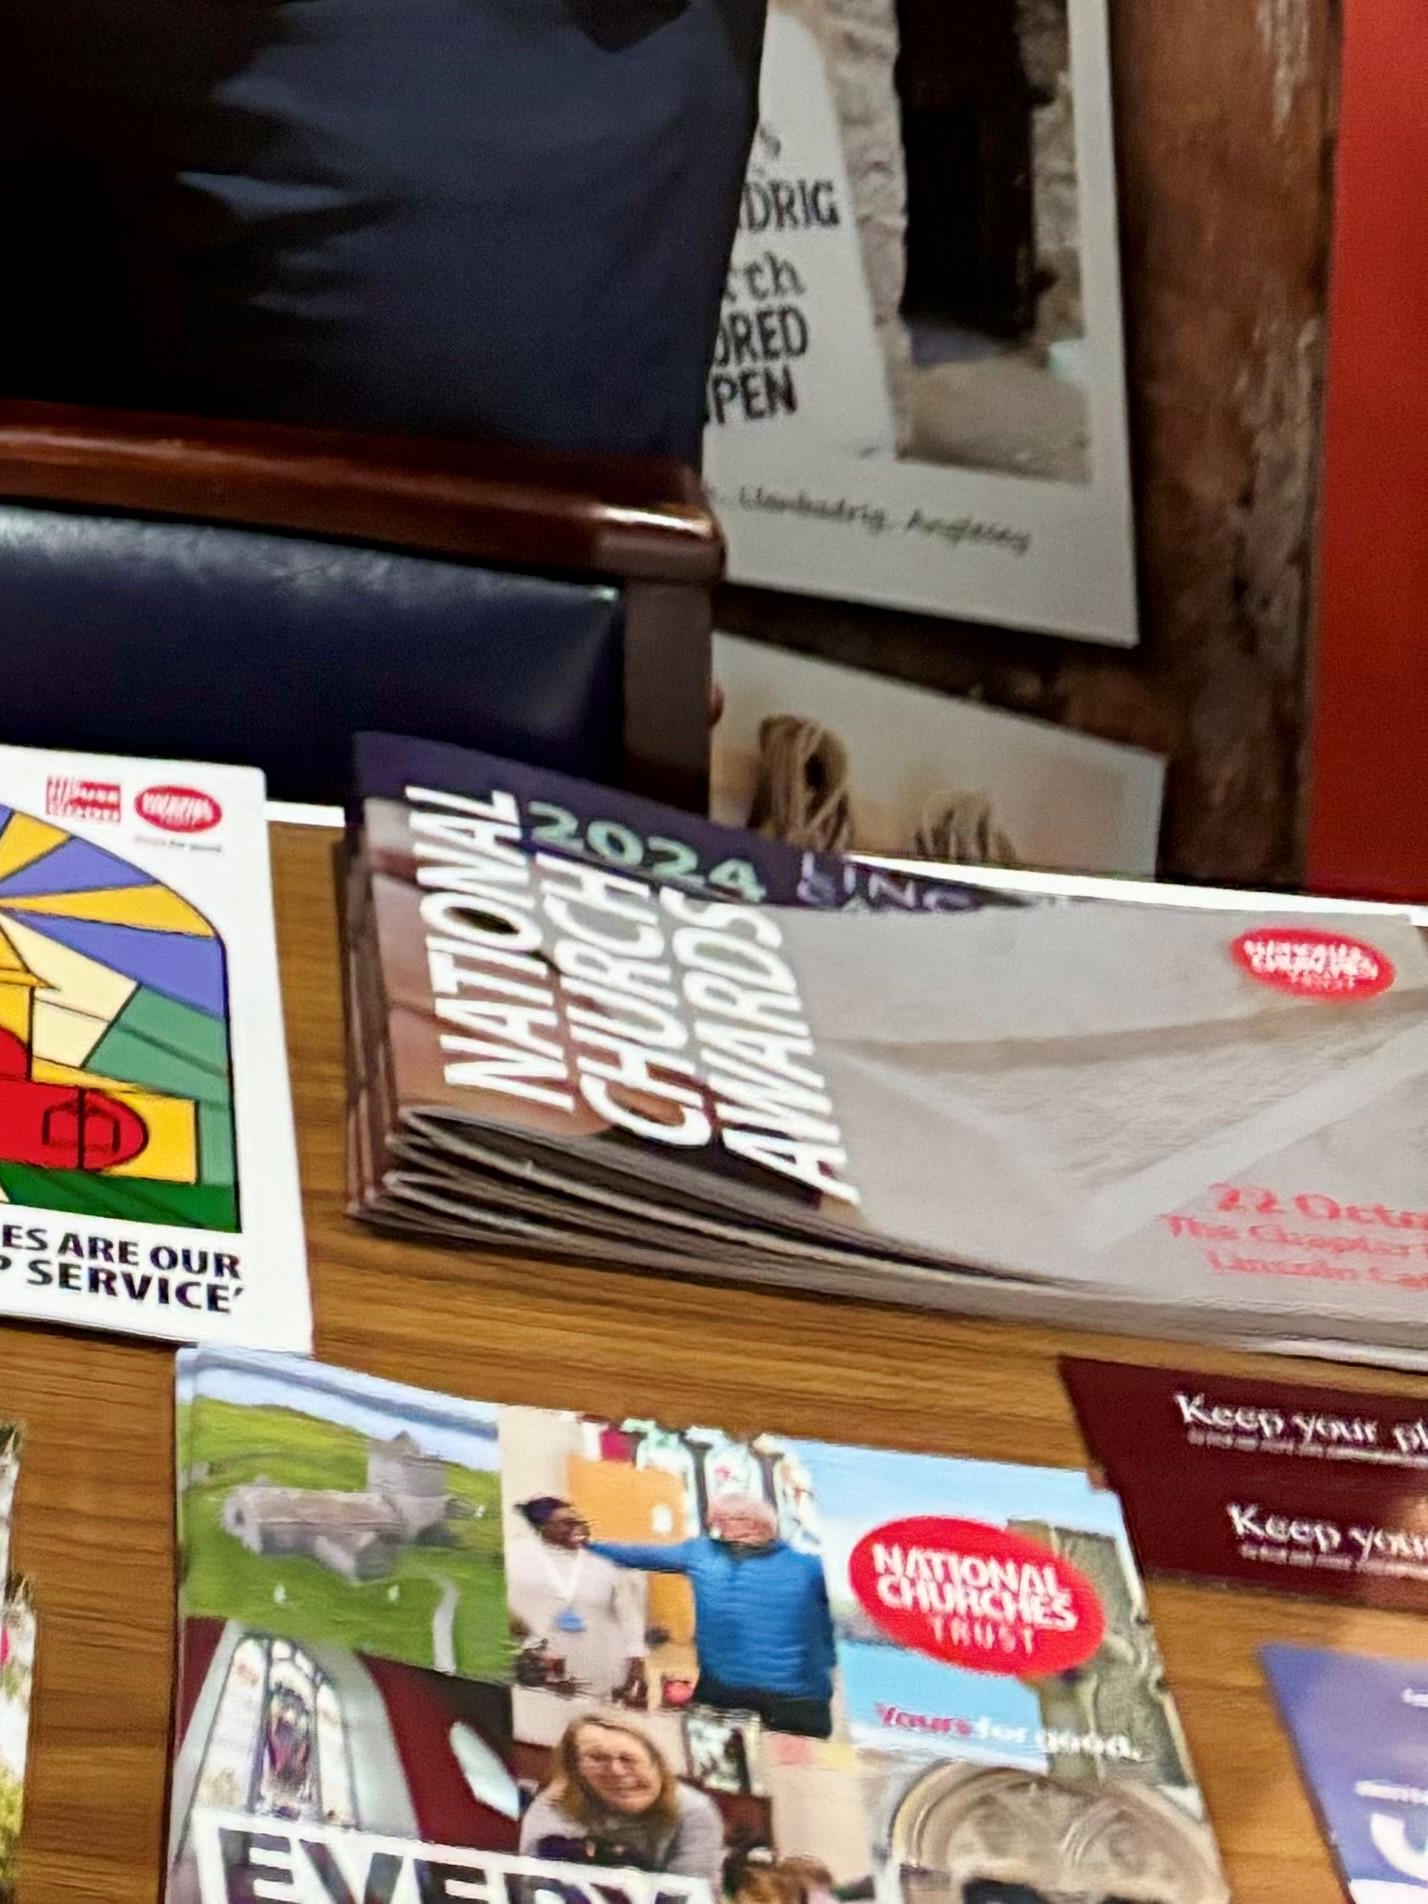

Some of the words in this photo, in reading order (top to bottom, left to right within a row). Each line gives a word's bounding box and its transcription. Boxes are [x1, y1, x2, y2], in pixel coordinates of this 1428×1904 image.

[738, 177, 839, 233] DRIG
[715, 304, 808, 369] RED
[708, 366, 797, 426] PEN
[526, 801, 767, 905] 2024
[404, 784, 576, 1112] NATIONAL
[535, 851, 712, 1148] CHURCH
[658, 885, 861, 1207] AWARDS
[57, 1232, 140, 1266] ARE
[149, 1244, 241, 1280] OUR
[25, 1257, 244, 1314] SERVICE'
[1174, 1391, 1284, 1439] Keep
[1291, 1414, 1379, 1443] your
[1227, 1503, 1342, 1553] Keep
[871, 1542, 1071, 1595] NATIONAL
[875, 1574, 1078, 1632] CHURCHES
[930, 1615, 1035, 1655] TRUST
[875, 1702, 973, 1737] Yours
[217, 1824, 694, 1904] EVERY
